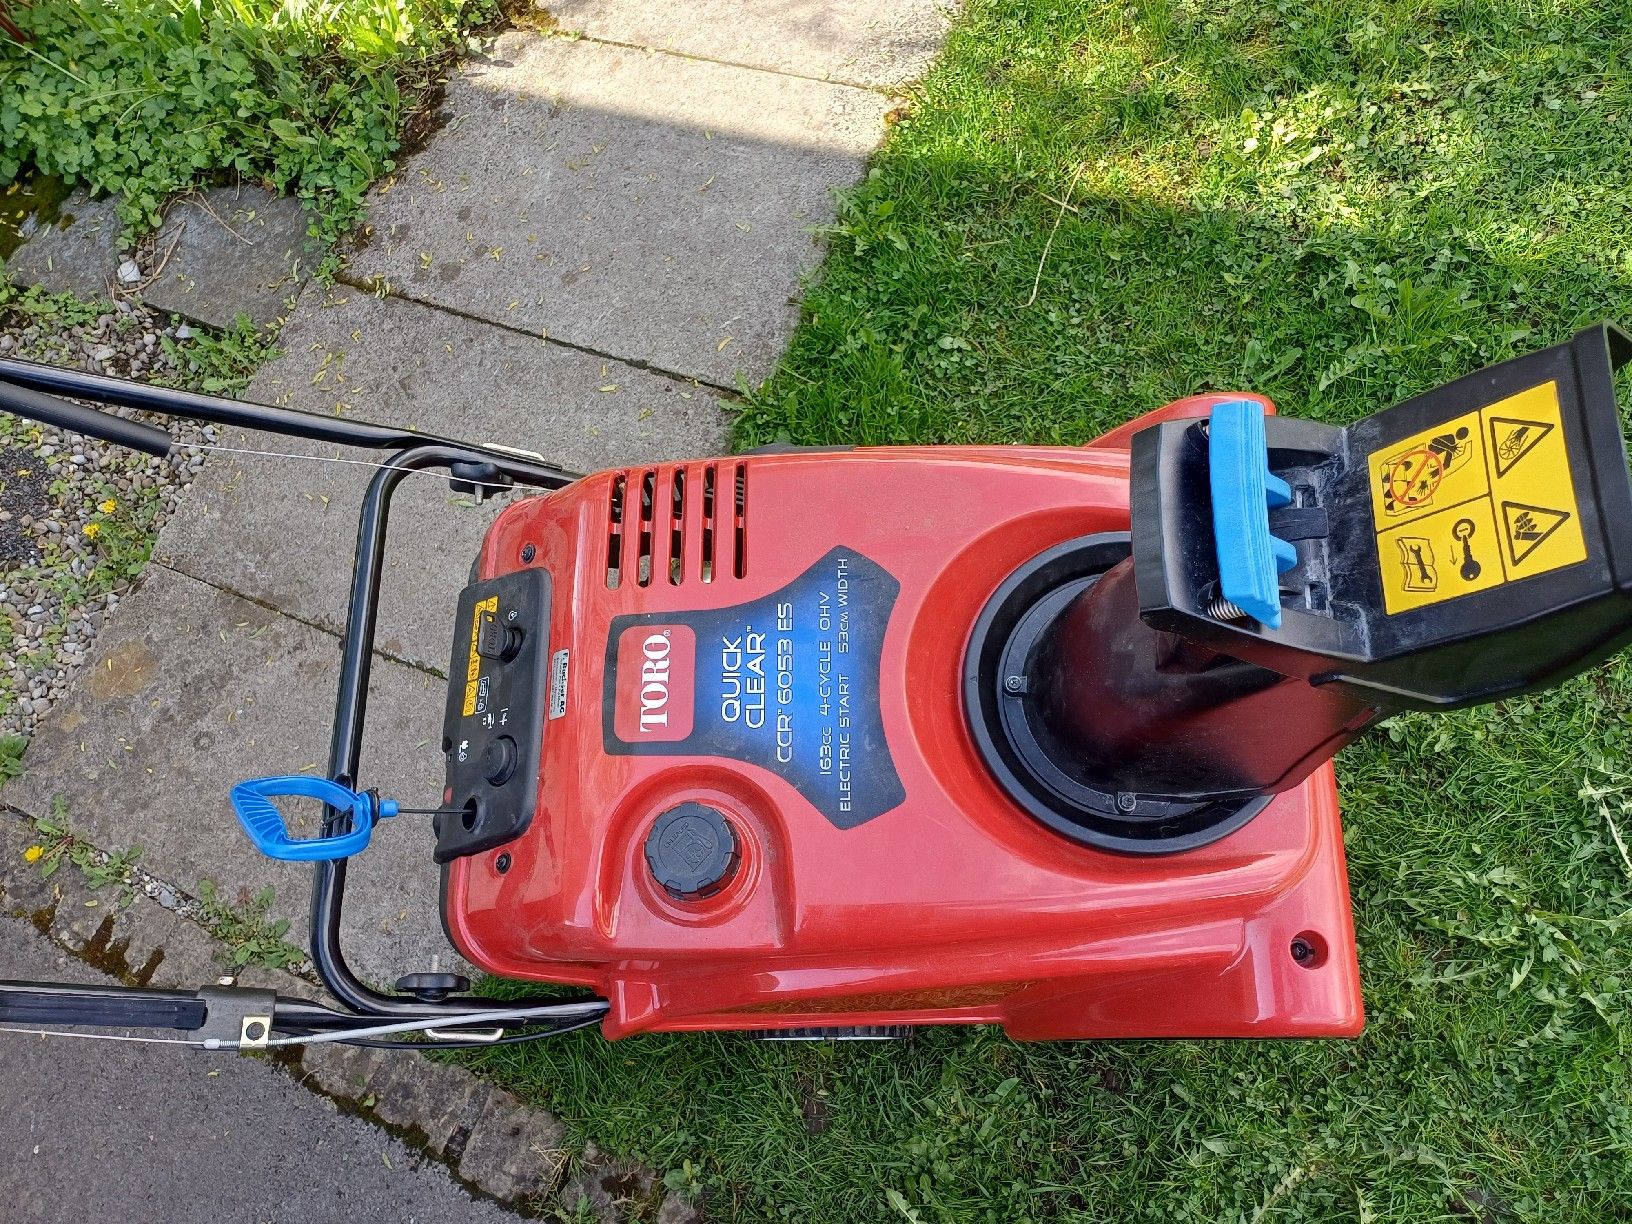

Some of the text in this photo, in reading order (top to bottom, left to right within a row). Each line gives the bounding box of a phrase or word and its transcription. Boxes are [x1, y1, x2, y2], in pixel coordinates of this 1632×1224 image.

[819, 591, 831, 631] OHV
[837, 558, 848, 609] WIDTH
[777, 602, 793, 631] ES
[721, 635, 742, 722] QUICK
[776, 638, 793, 705] 6053
[819, 641, 831, 716] 4-CYCLE
[839, 673, 850, 728] START
[839, 732, 851, 812] ELECTRIC
